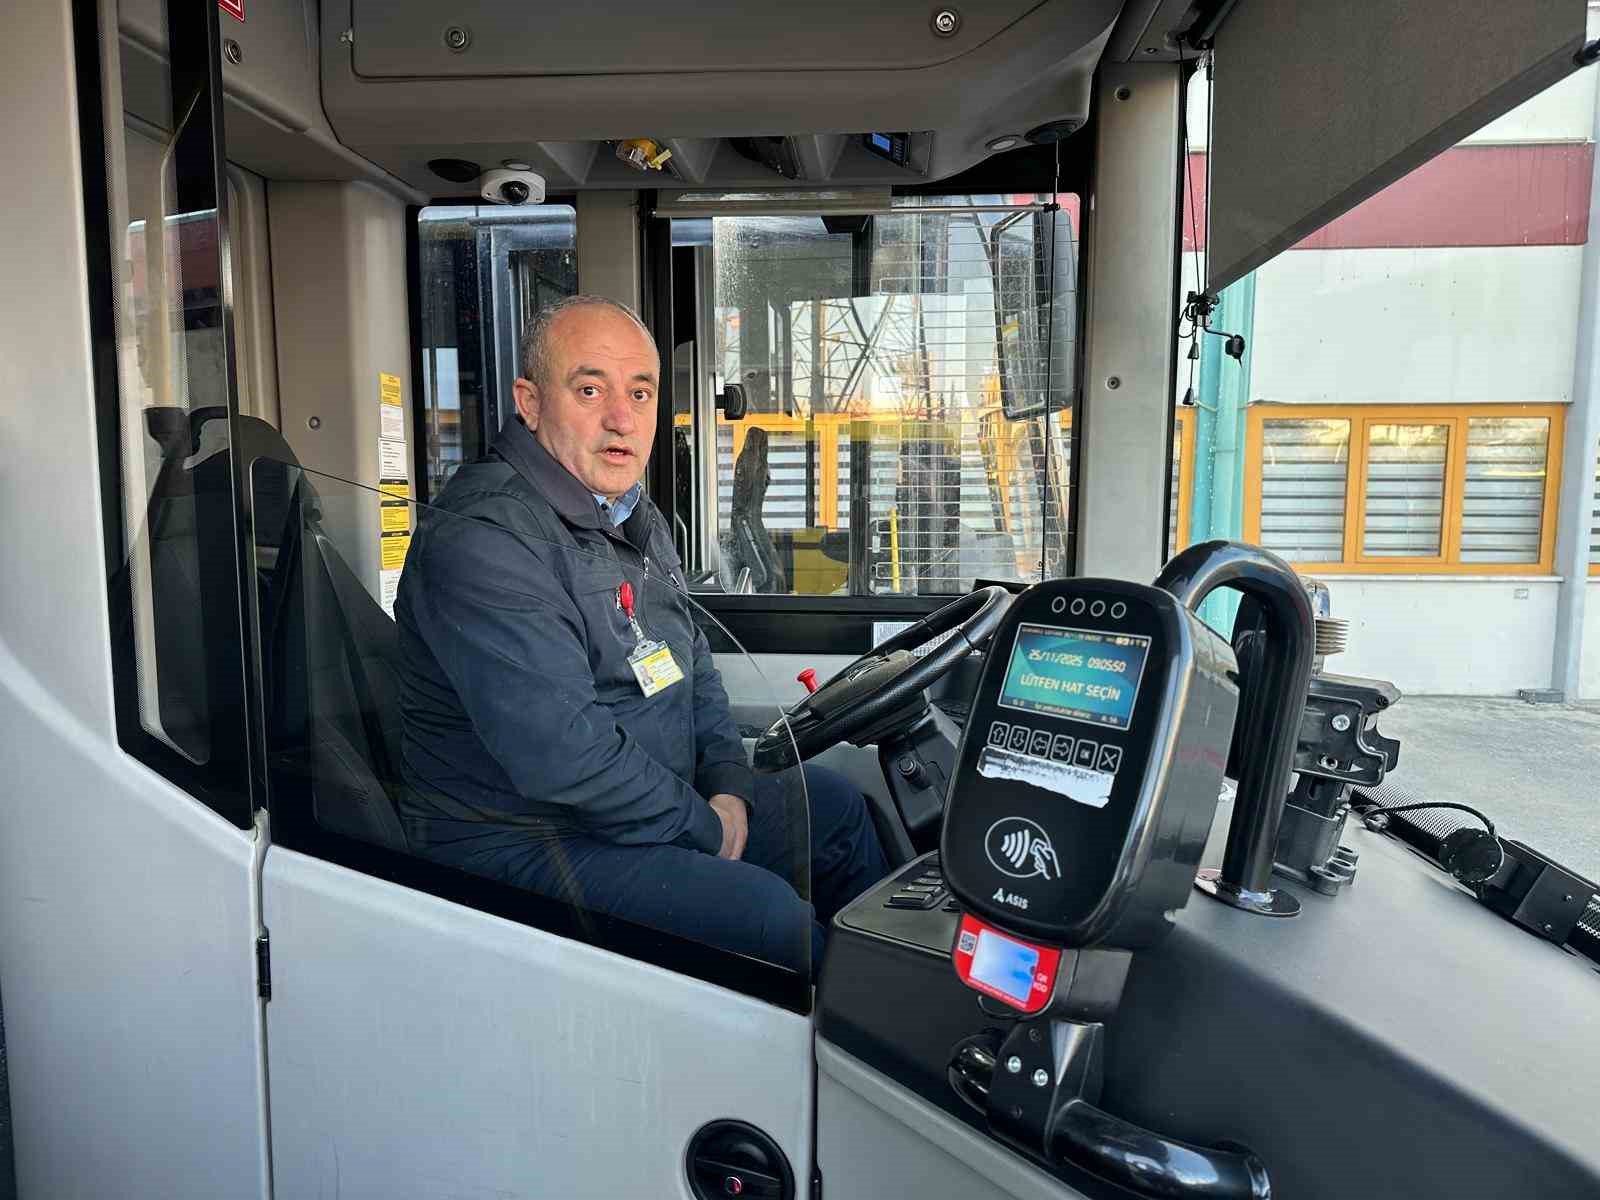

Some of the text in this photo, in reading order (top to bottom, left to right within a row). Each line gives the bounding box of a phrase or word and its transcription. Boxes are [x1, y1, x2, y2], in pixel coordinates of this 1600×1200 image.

[1020, 673, 1120, 701] LÜTFEN HAT SEÇİN
